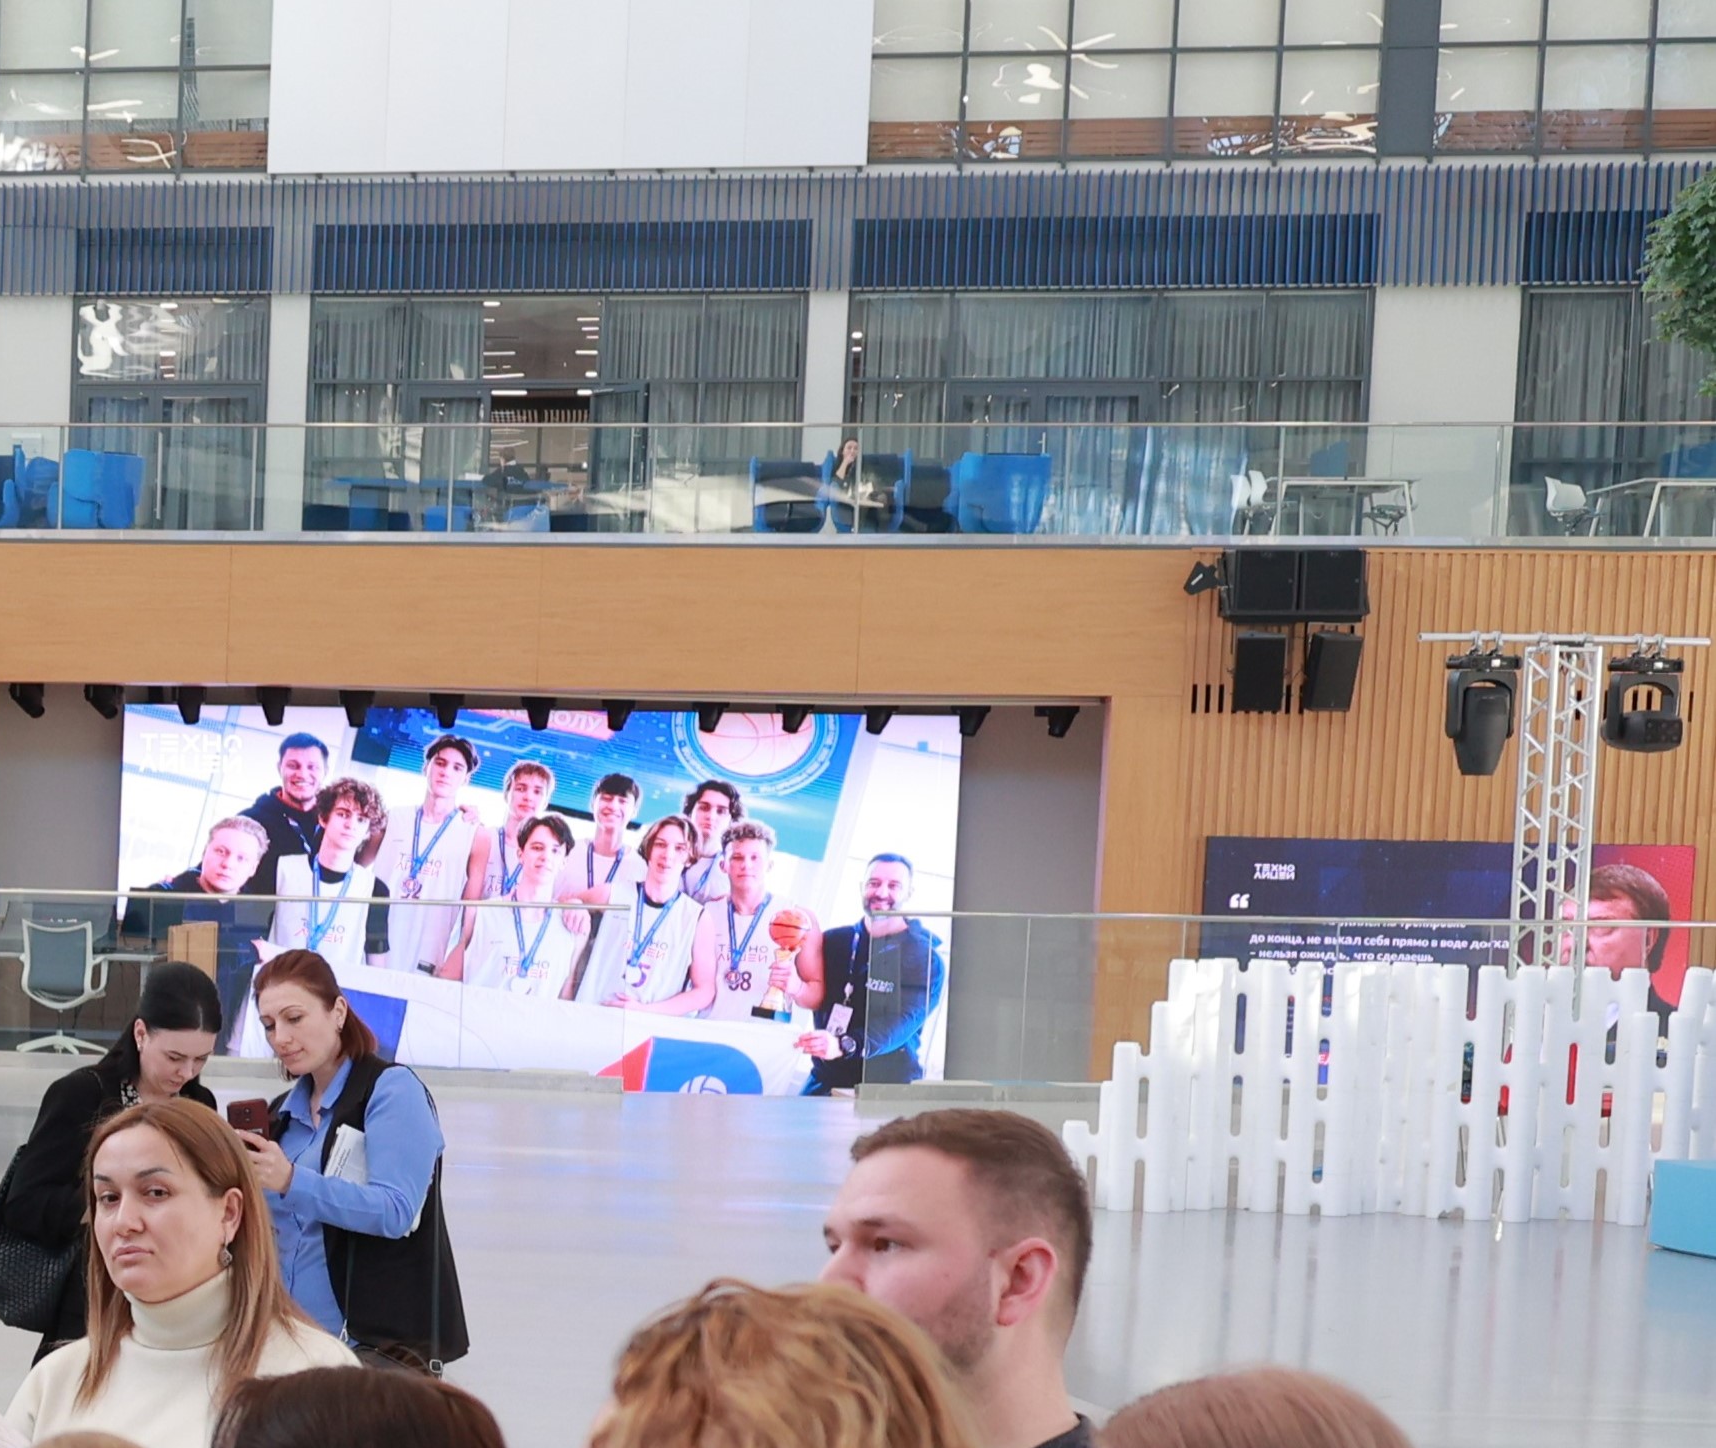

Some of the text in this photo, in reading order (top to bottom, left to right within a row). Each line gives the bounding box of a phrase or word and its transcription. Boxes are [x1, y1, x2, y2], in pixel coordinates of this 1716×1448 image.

[140, 733, 243, 753] ТЕХНО
[399, 852, 442, 868] ТЕНО
[1254, 863, 1295, 872] ТЕХНО
[718, 943, 768, 954] ТЕНО
[1249, 934, 1265, 945] до
[1267, 935, 1305, 946] конца,
[1307, 936, 1322, 945] не
[1363, 934, 1390, 946] себя
[1392, 938, 1429, 949] прямо
[1431, 939, 1438, 948] в
[1440, 939, 1468, 950] воде
[1258, 949, 1298, 959] нельзя
[1354, 952, 1375, 961] что
[1376, 952, 1434, 962] сделаешь
[503, 956, 550, 970] ТЕНО
